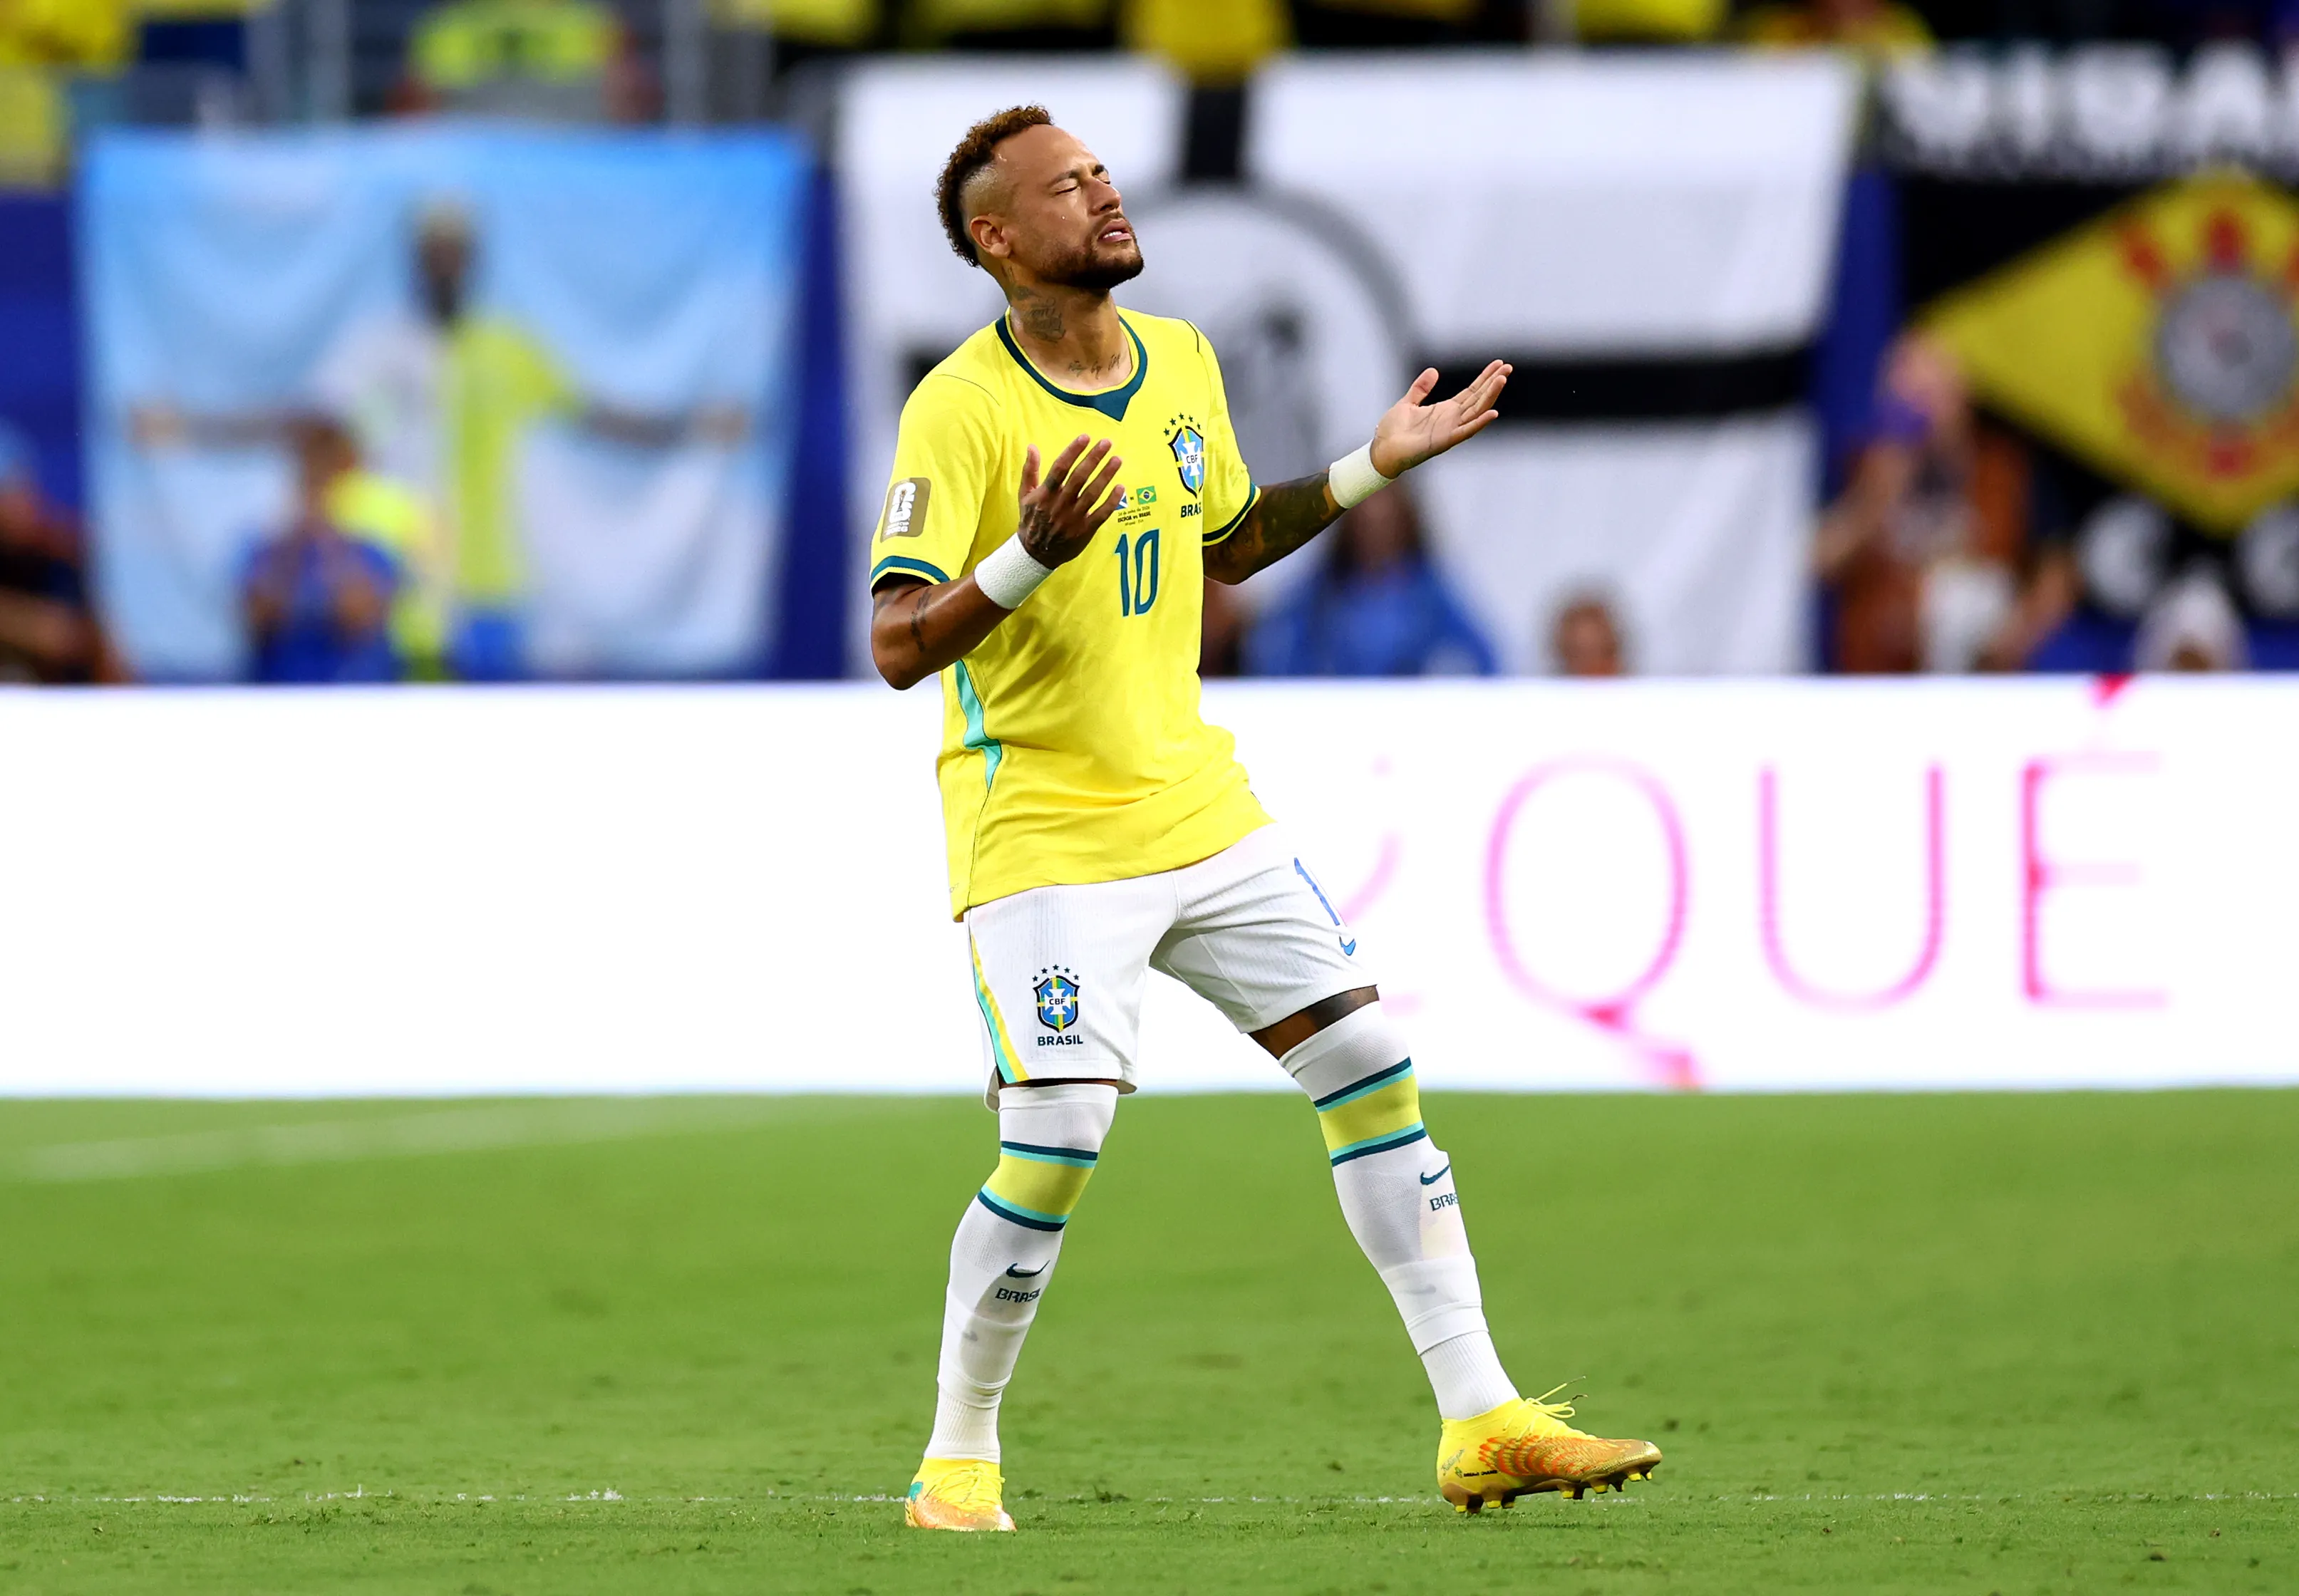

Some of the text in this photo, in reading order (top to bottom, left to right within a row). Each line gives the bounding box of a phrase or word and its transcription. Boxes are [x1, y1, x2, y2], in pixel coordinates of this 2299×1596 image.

[1187, 454, 1197, 464] CBF
[1115, 529, 1159, 617] 10
[1038, 1035, 1083, 1046] BRASIL
